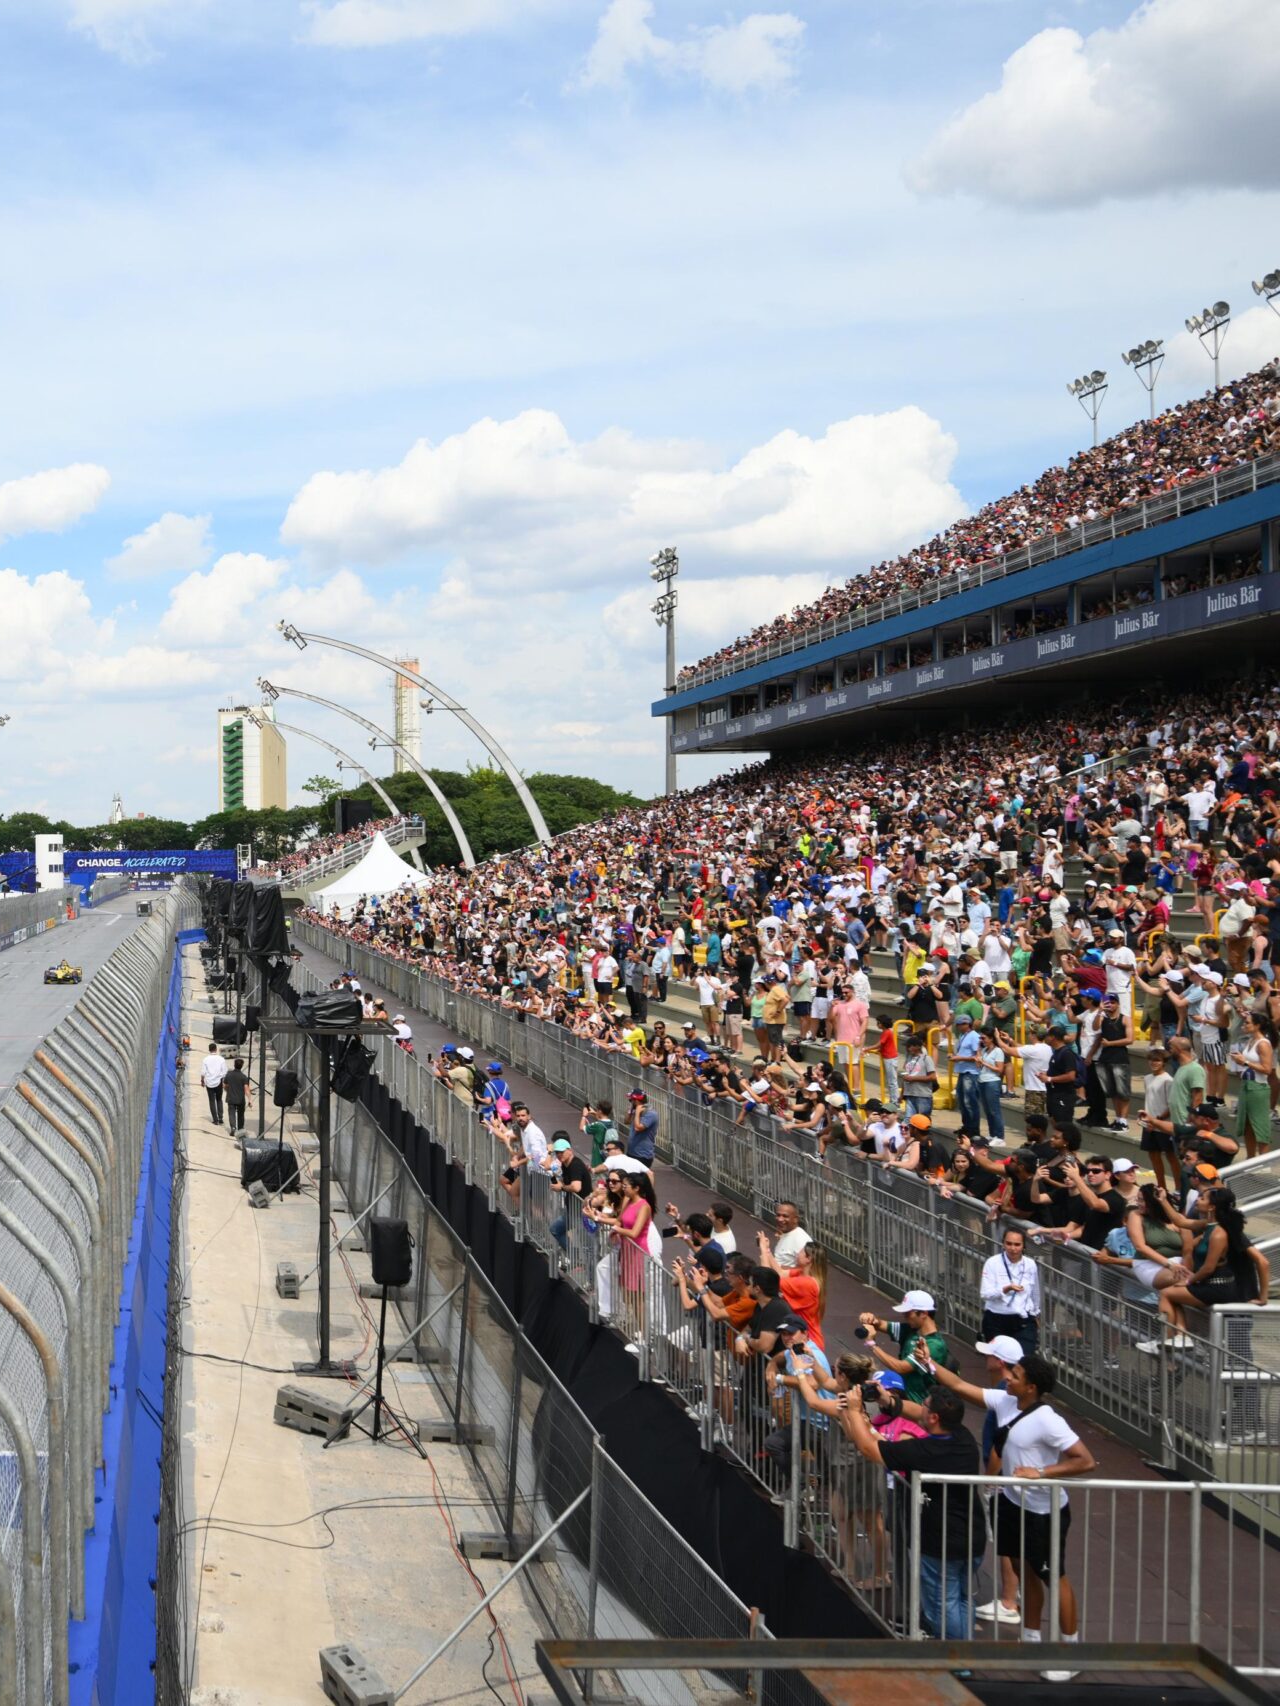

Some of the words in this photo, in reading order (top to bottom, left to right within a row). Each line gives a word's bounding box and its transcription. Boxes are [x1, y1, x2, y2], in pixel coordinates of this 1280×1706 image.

[1206, 592, 1238, 617] Julius
[1240, 585, 1262, 605] Bär
[1114, 617, 1141, 640] Julius
[1142, 611, 1161, 629] Bär
[1037, 639, 1059, 659] Julius
[1060, 633, 1076, 650] Bär
[972, 657, 990, 674] Julius
[991, 652, 1005, 667] Bär
[916, 670, 932, 687] Julius
[76, 858, 123, 867] CHANGE.
